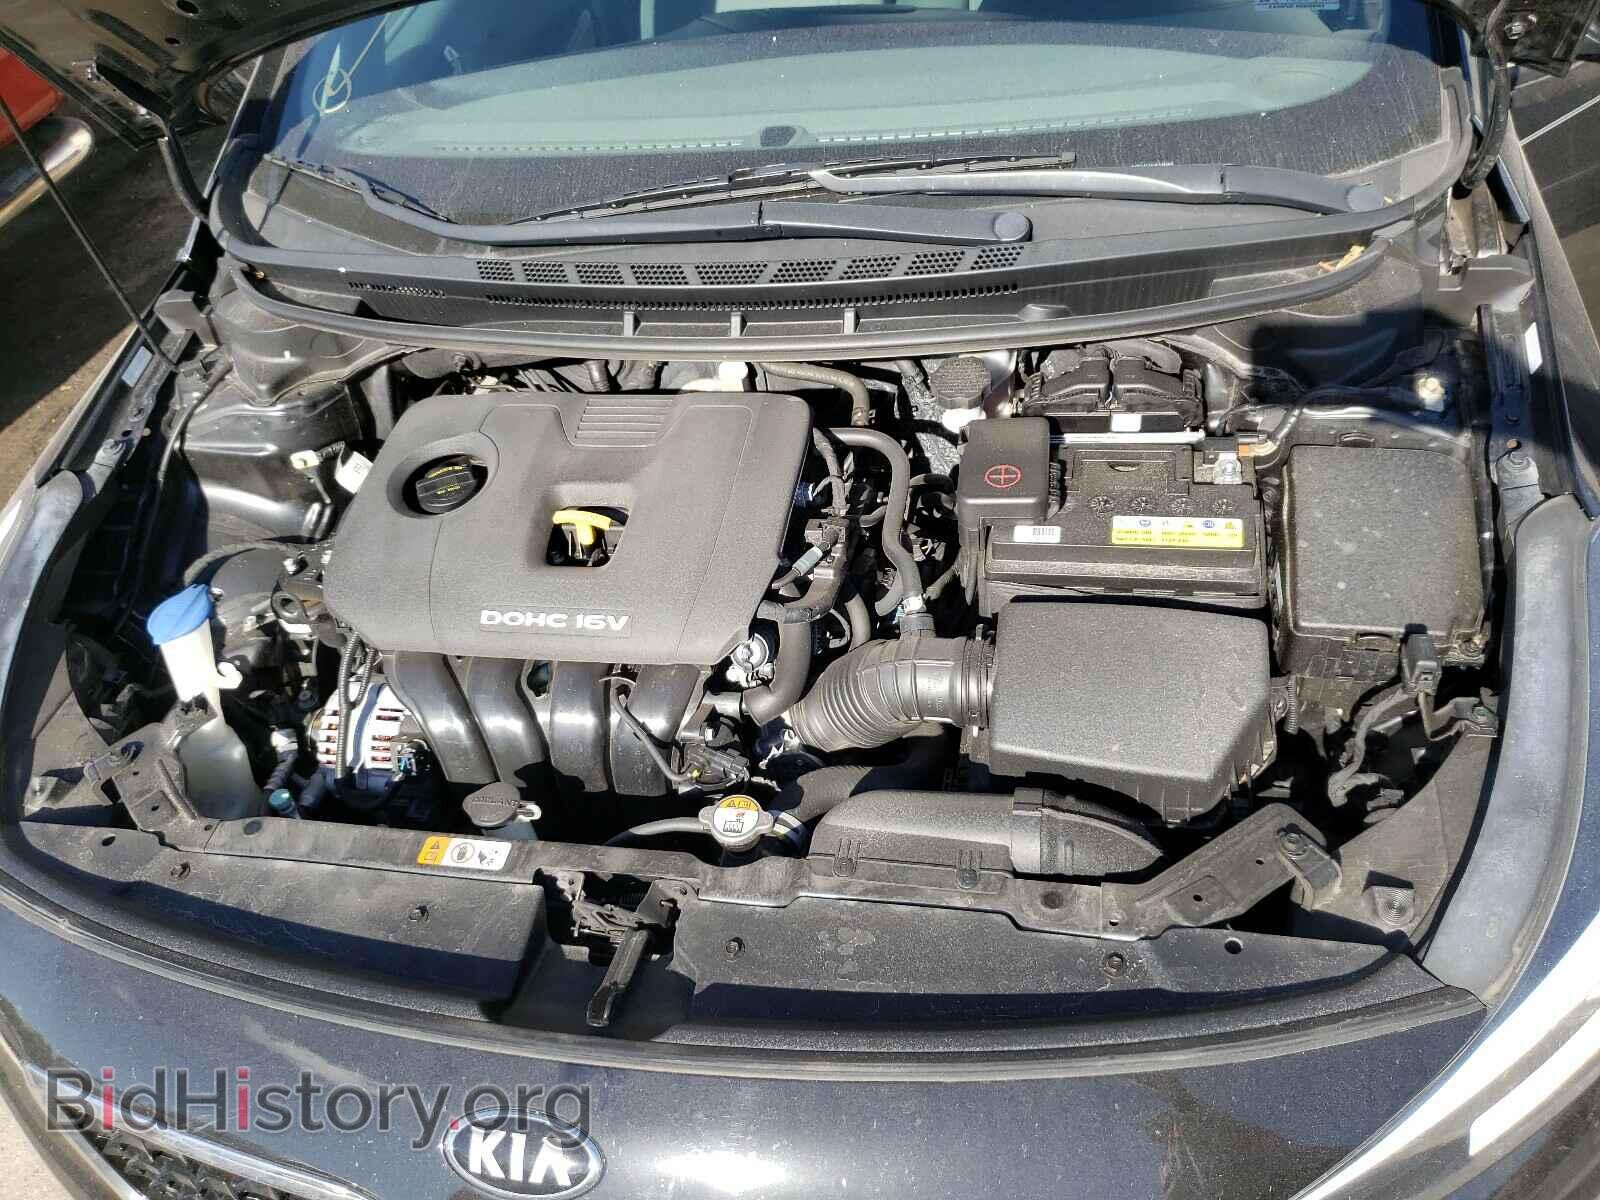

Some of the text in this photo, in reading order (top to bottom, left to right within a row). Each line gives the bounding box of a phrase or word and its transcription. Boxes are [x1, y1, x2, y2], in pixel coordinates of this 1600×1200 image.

[480, 610, 629, 631] DOHC 16V
[469, 1126, 572, 1186] KIA
